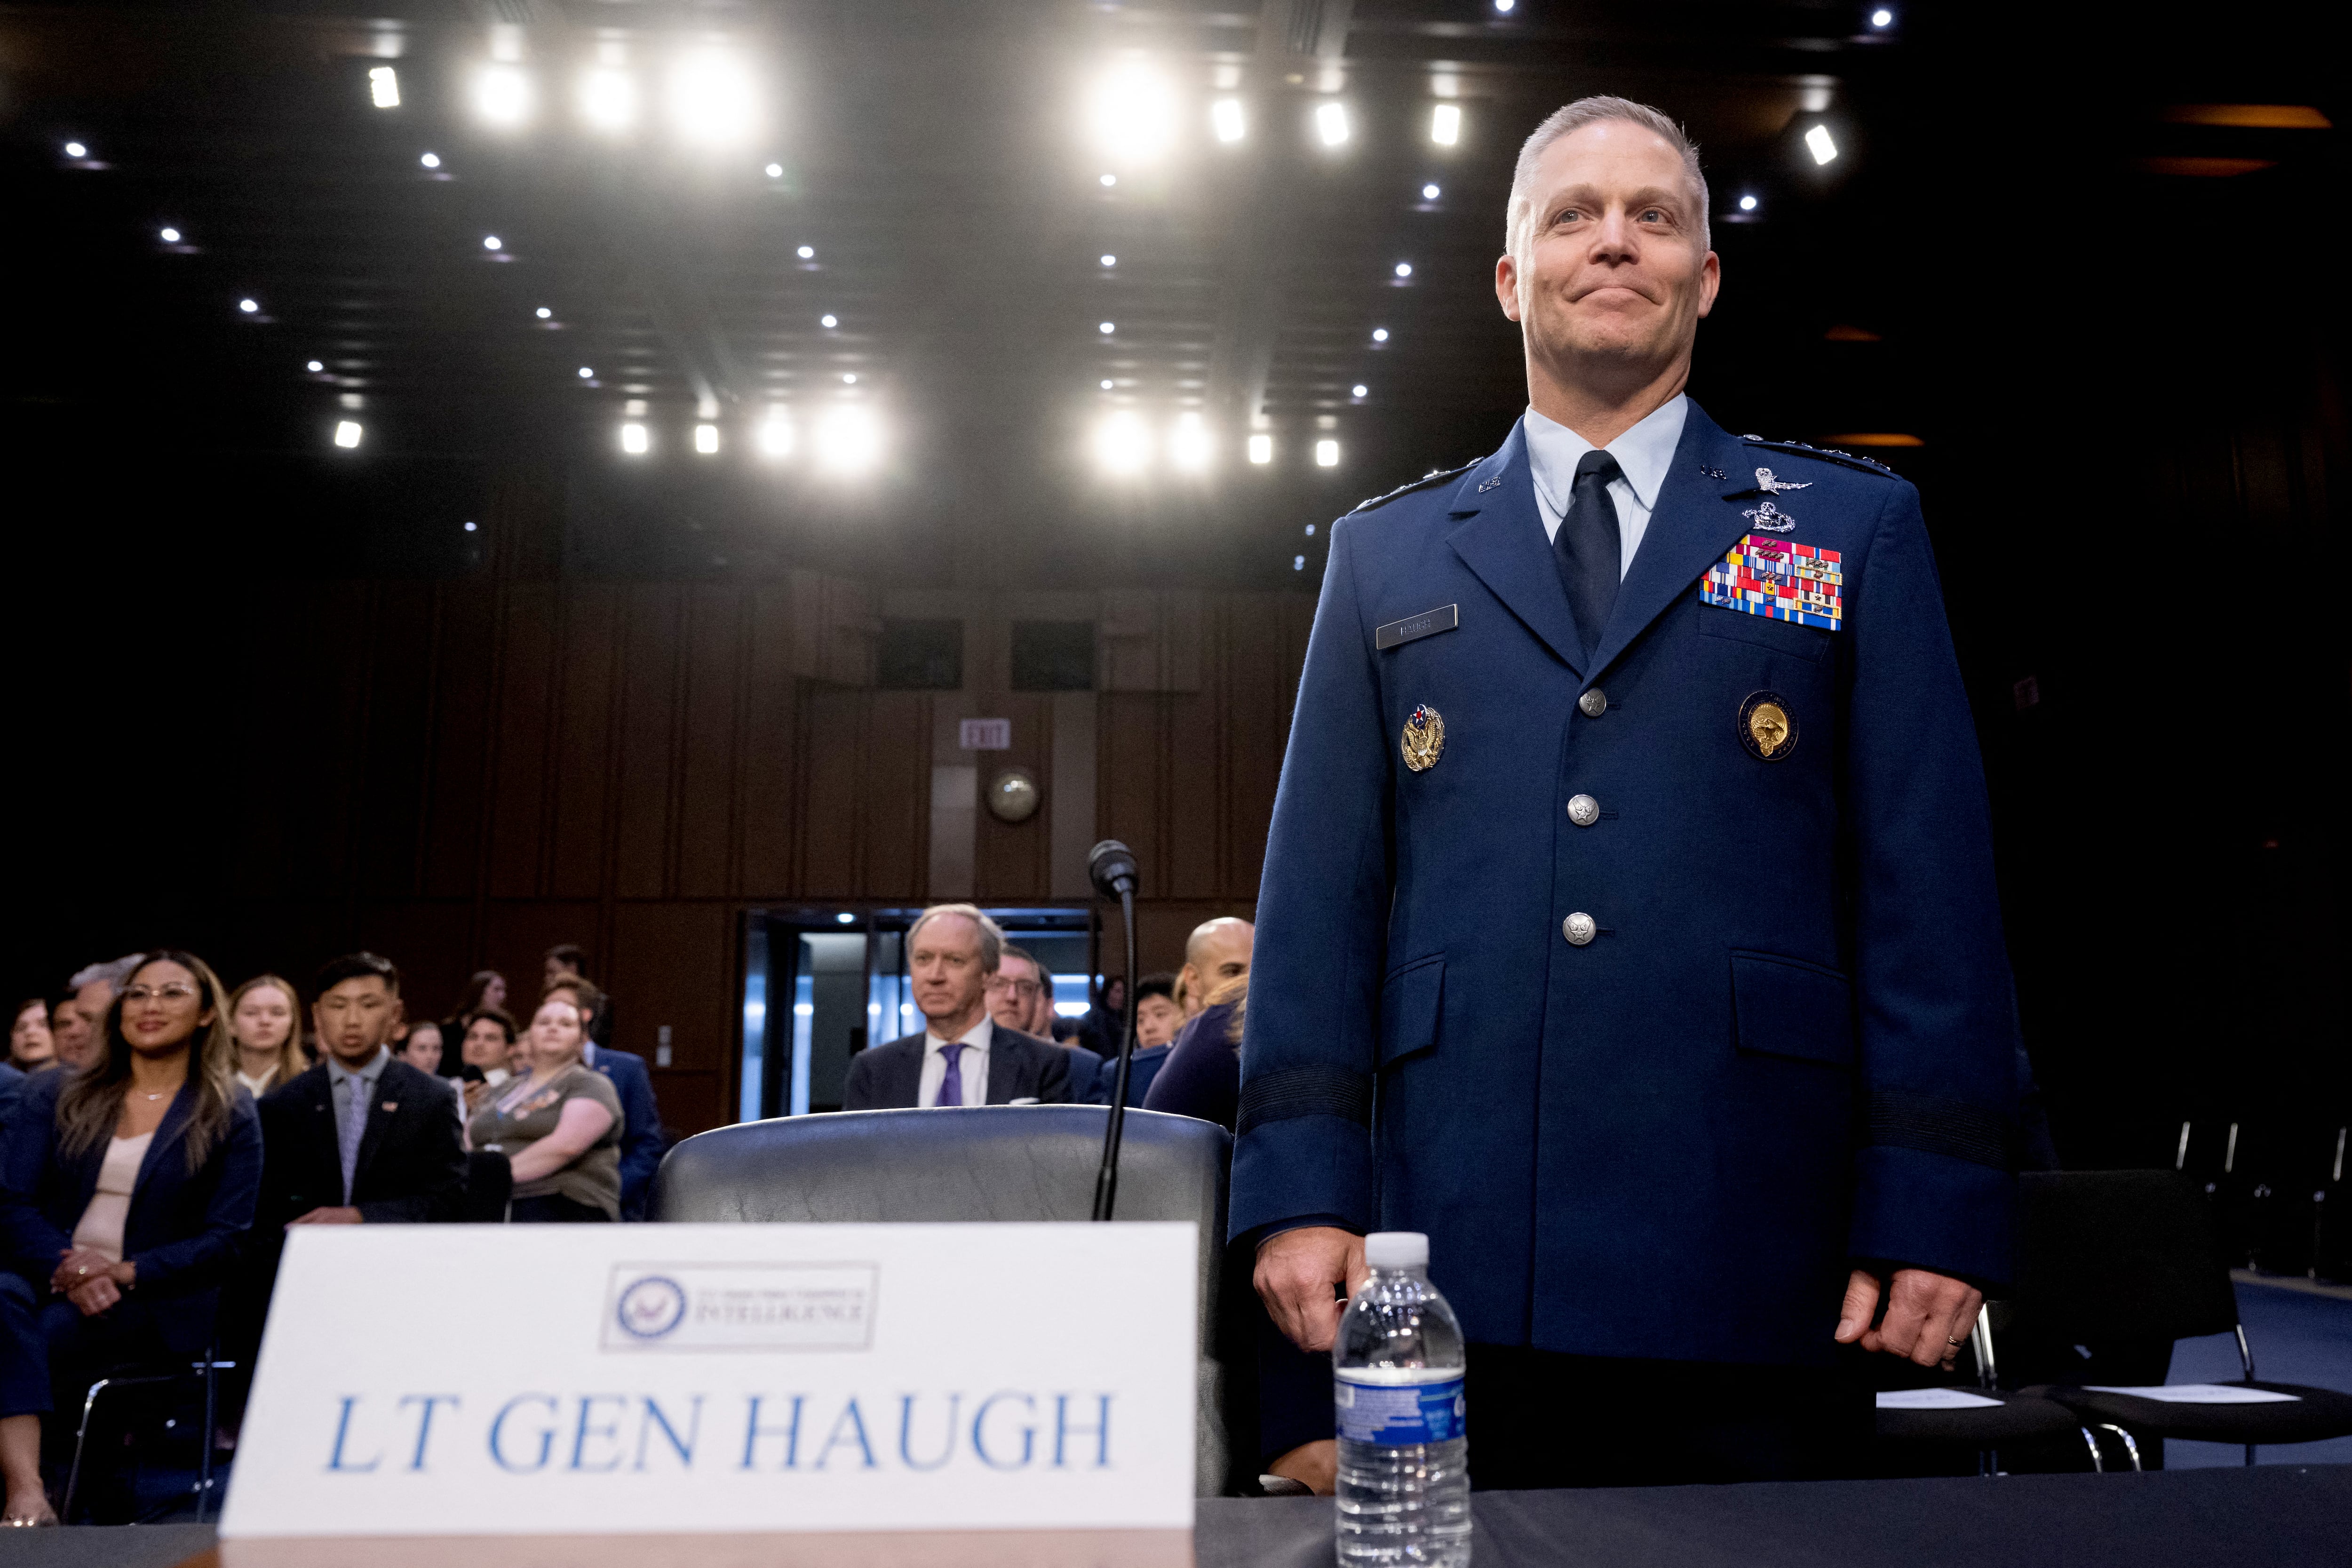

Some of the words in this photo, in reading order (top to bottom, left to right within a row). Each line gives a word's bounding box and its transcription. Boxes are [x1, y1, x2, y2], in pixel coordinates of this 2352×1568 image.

[1400, 619, 1431, 636] HAUGH
[325, 1393, 461, 1473] LT
[487, 1393, 706, 1472] GEN
[739, 1391, 1115, 1472] HAUGH
